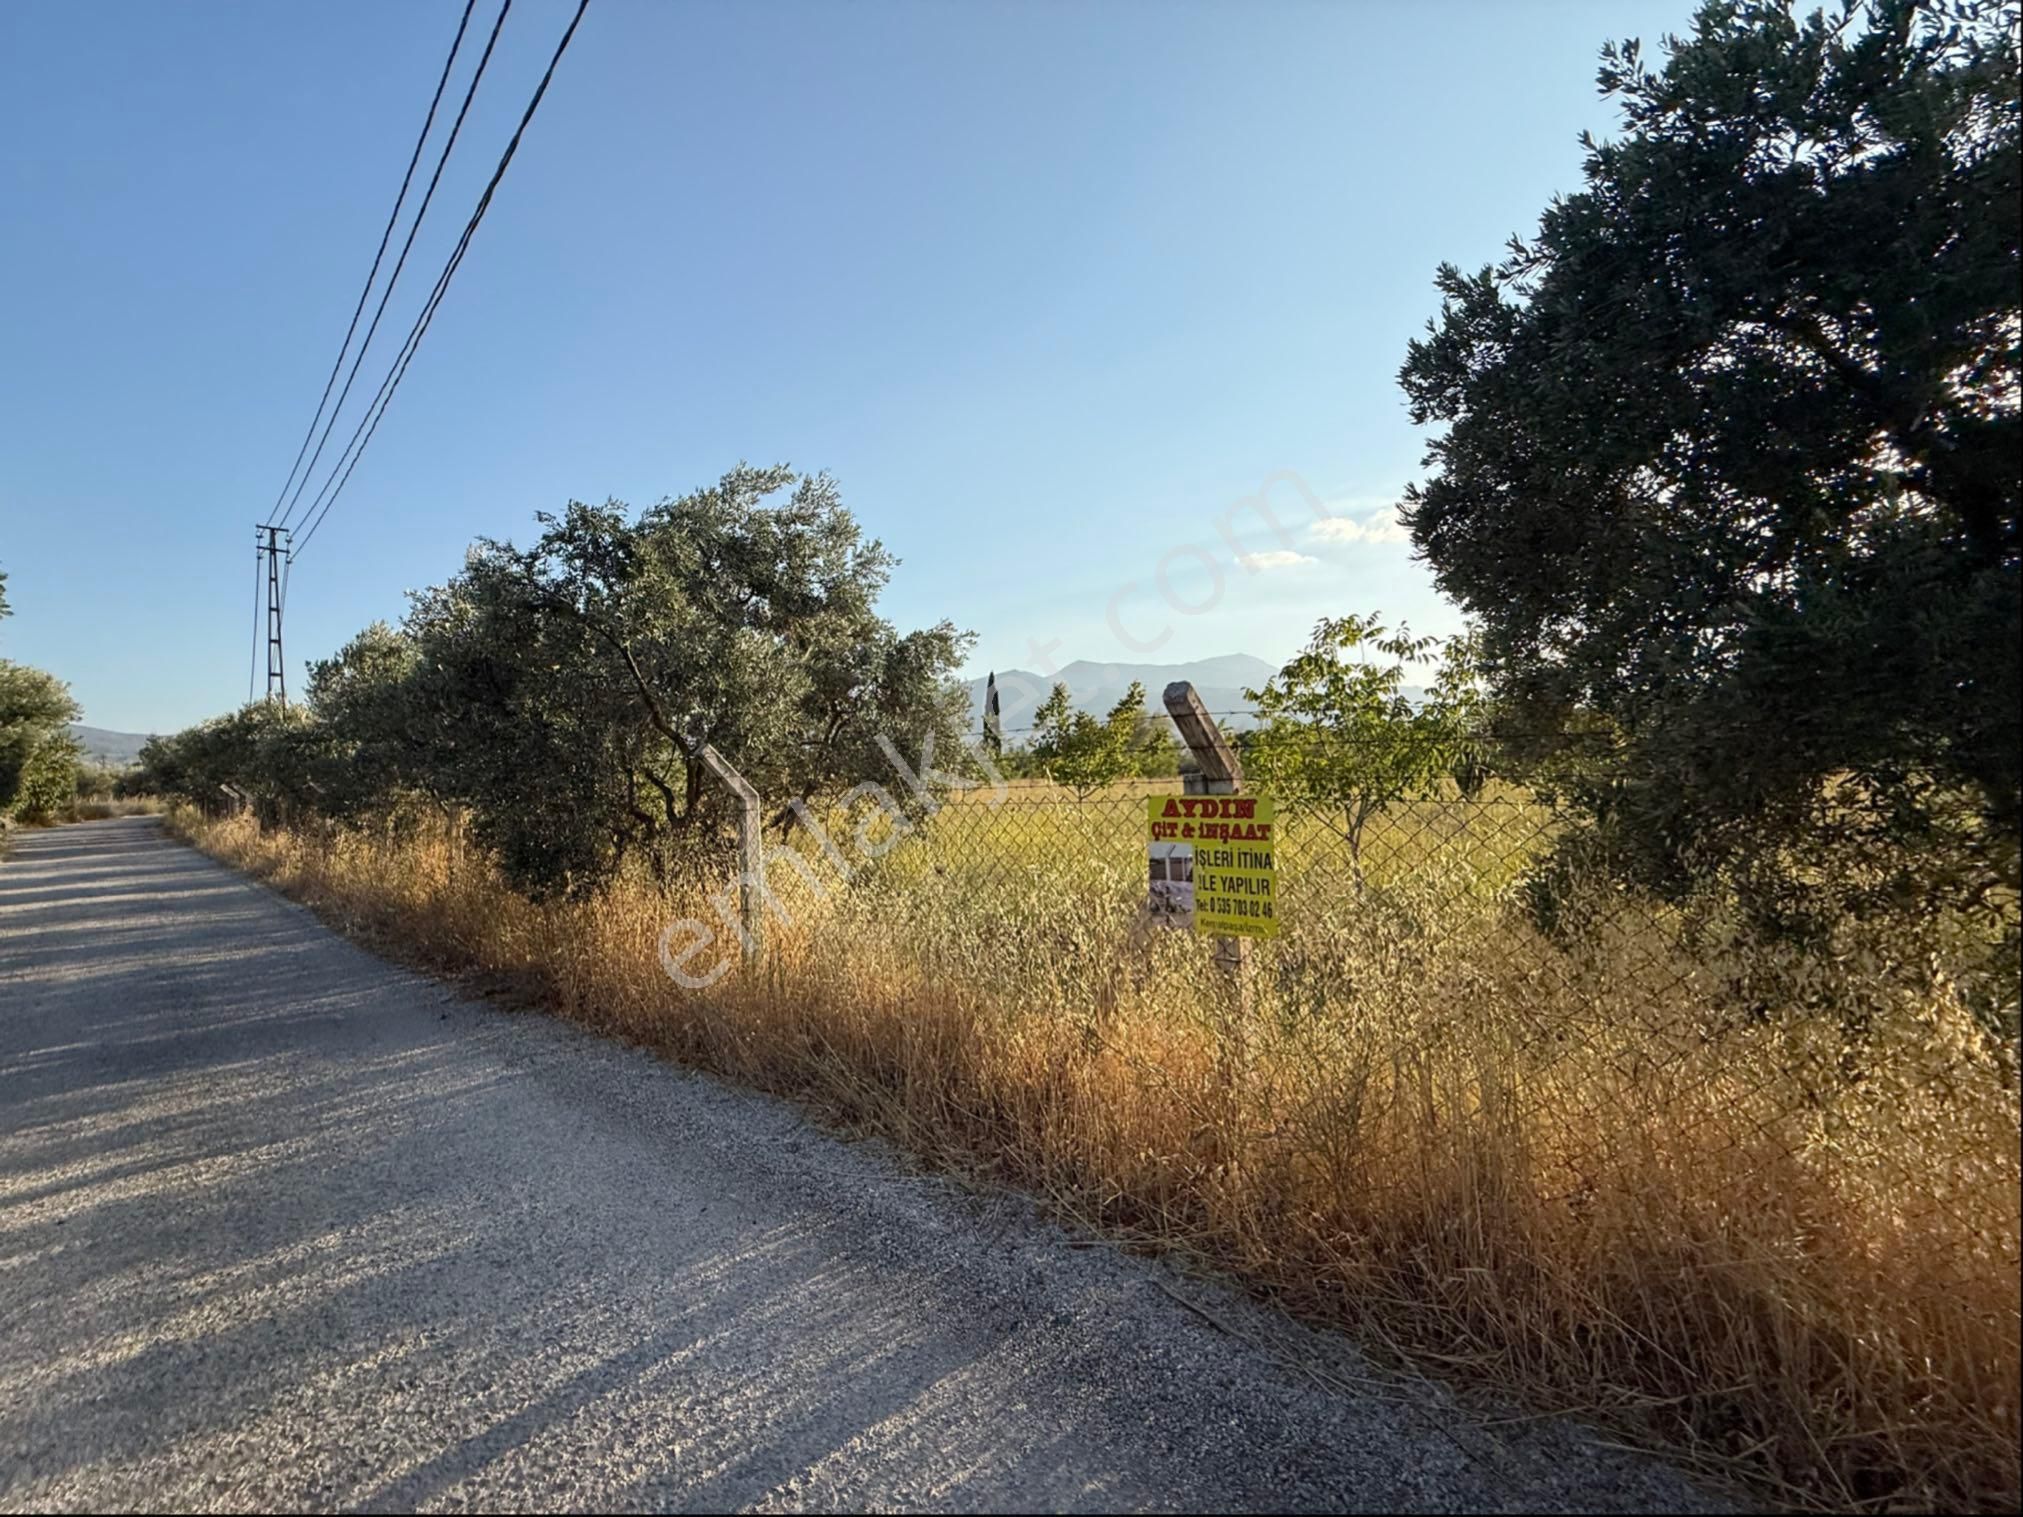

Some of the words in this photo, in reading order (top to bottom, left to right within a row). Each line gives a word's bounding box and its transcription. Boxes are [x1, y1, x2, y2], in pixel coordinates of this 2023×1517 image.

[1162, 798, 1257, 819] AYDIN
[1182, 822, 1195, 838] &
[1220, 876, 1270, 896] YAPILIR
[1249, 901, 1260, 918] 02
